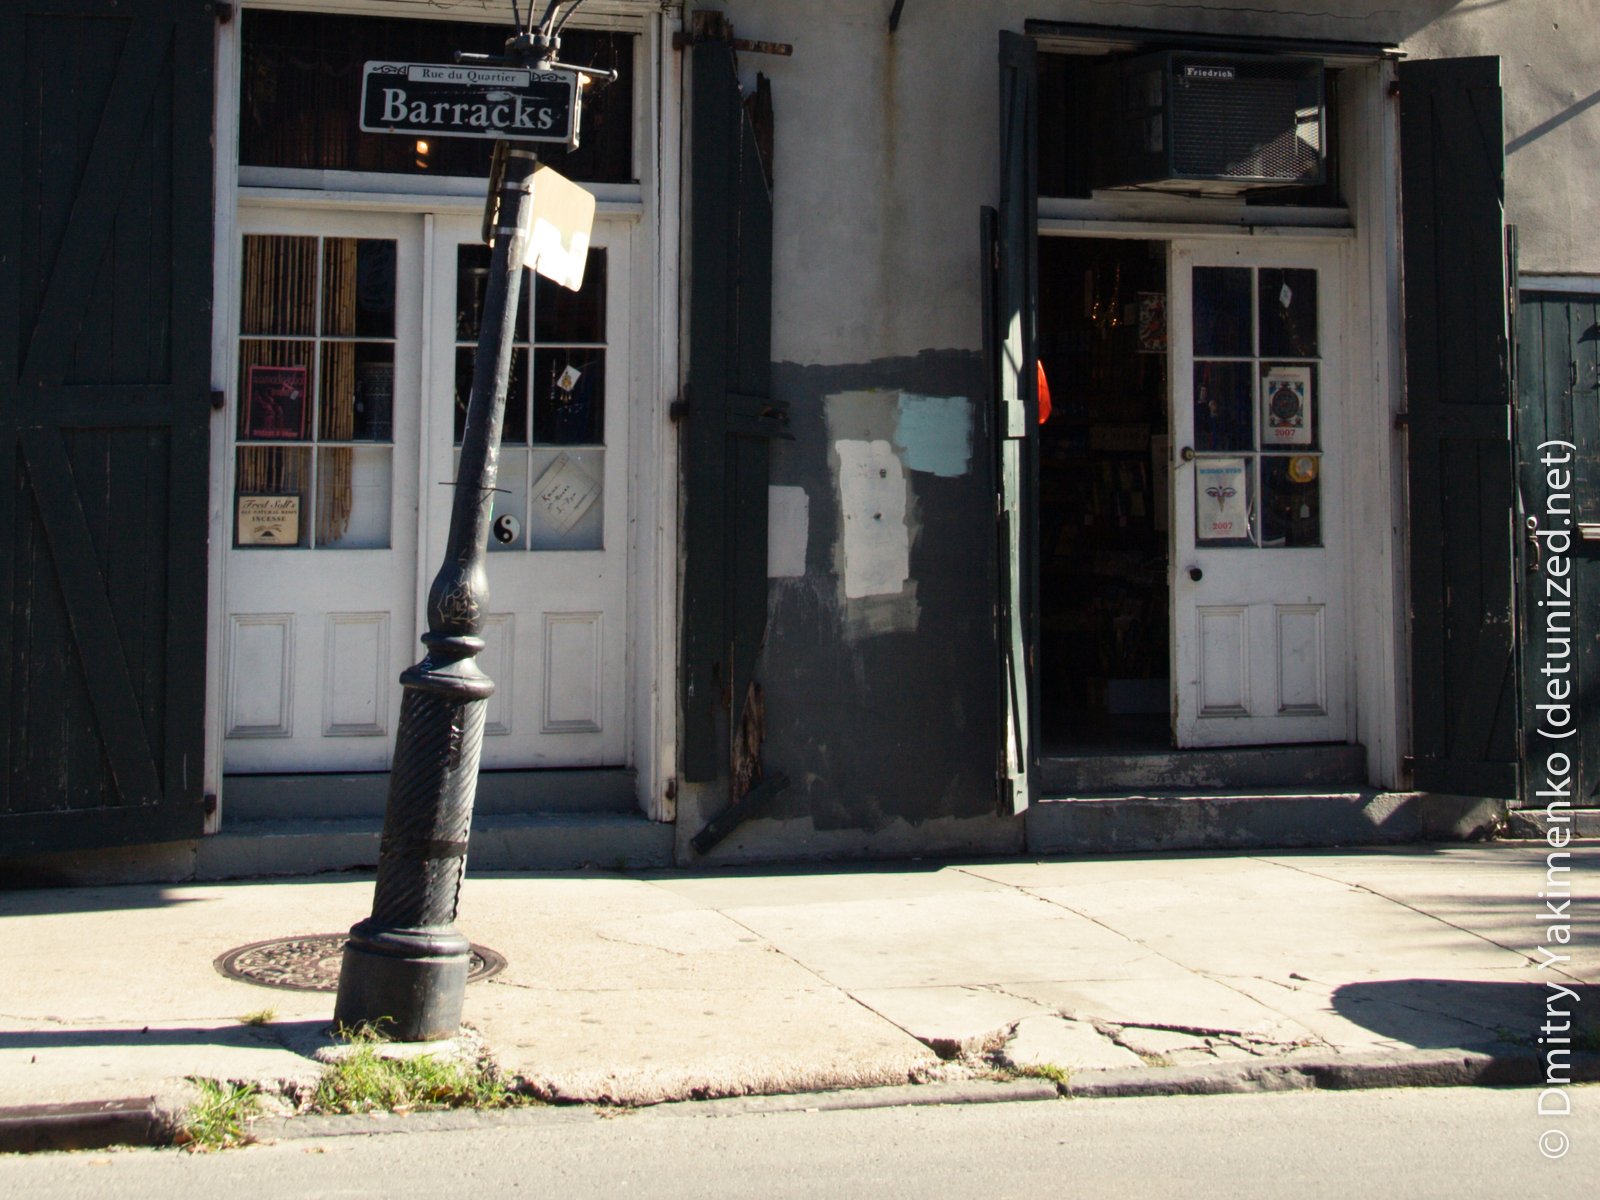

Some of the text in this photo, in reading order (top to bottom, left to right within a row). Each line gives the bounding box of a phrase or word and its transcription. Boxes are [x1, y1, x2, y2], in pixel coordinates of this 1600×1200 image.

[422, 68, 516, 83] Rue du Quartier
[1187, 67, 1233, 78] Friedrich
[380, 87, 553, 130] Barracks
[1212, 522, 1233, 530] 2007
